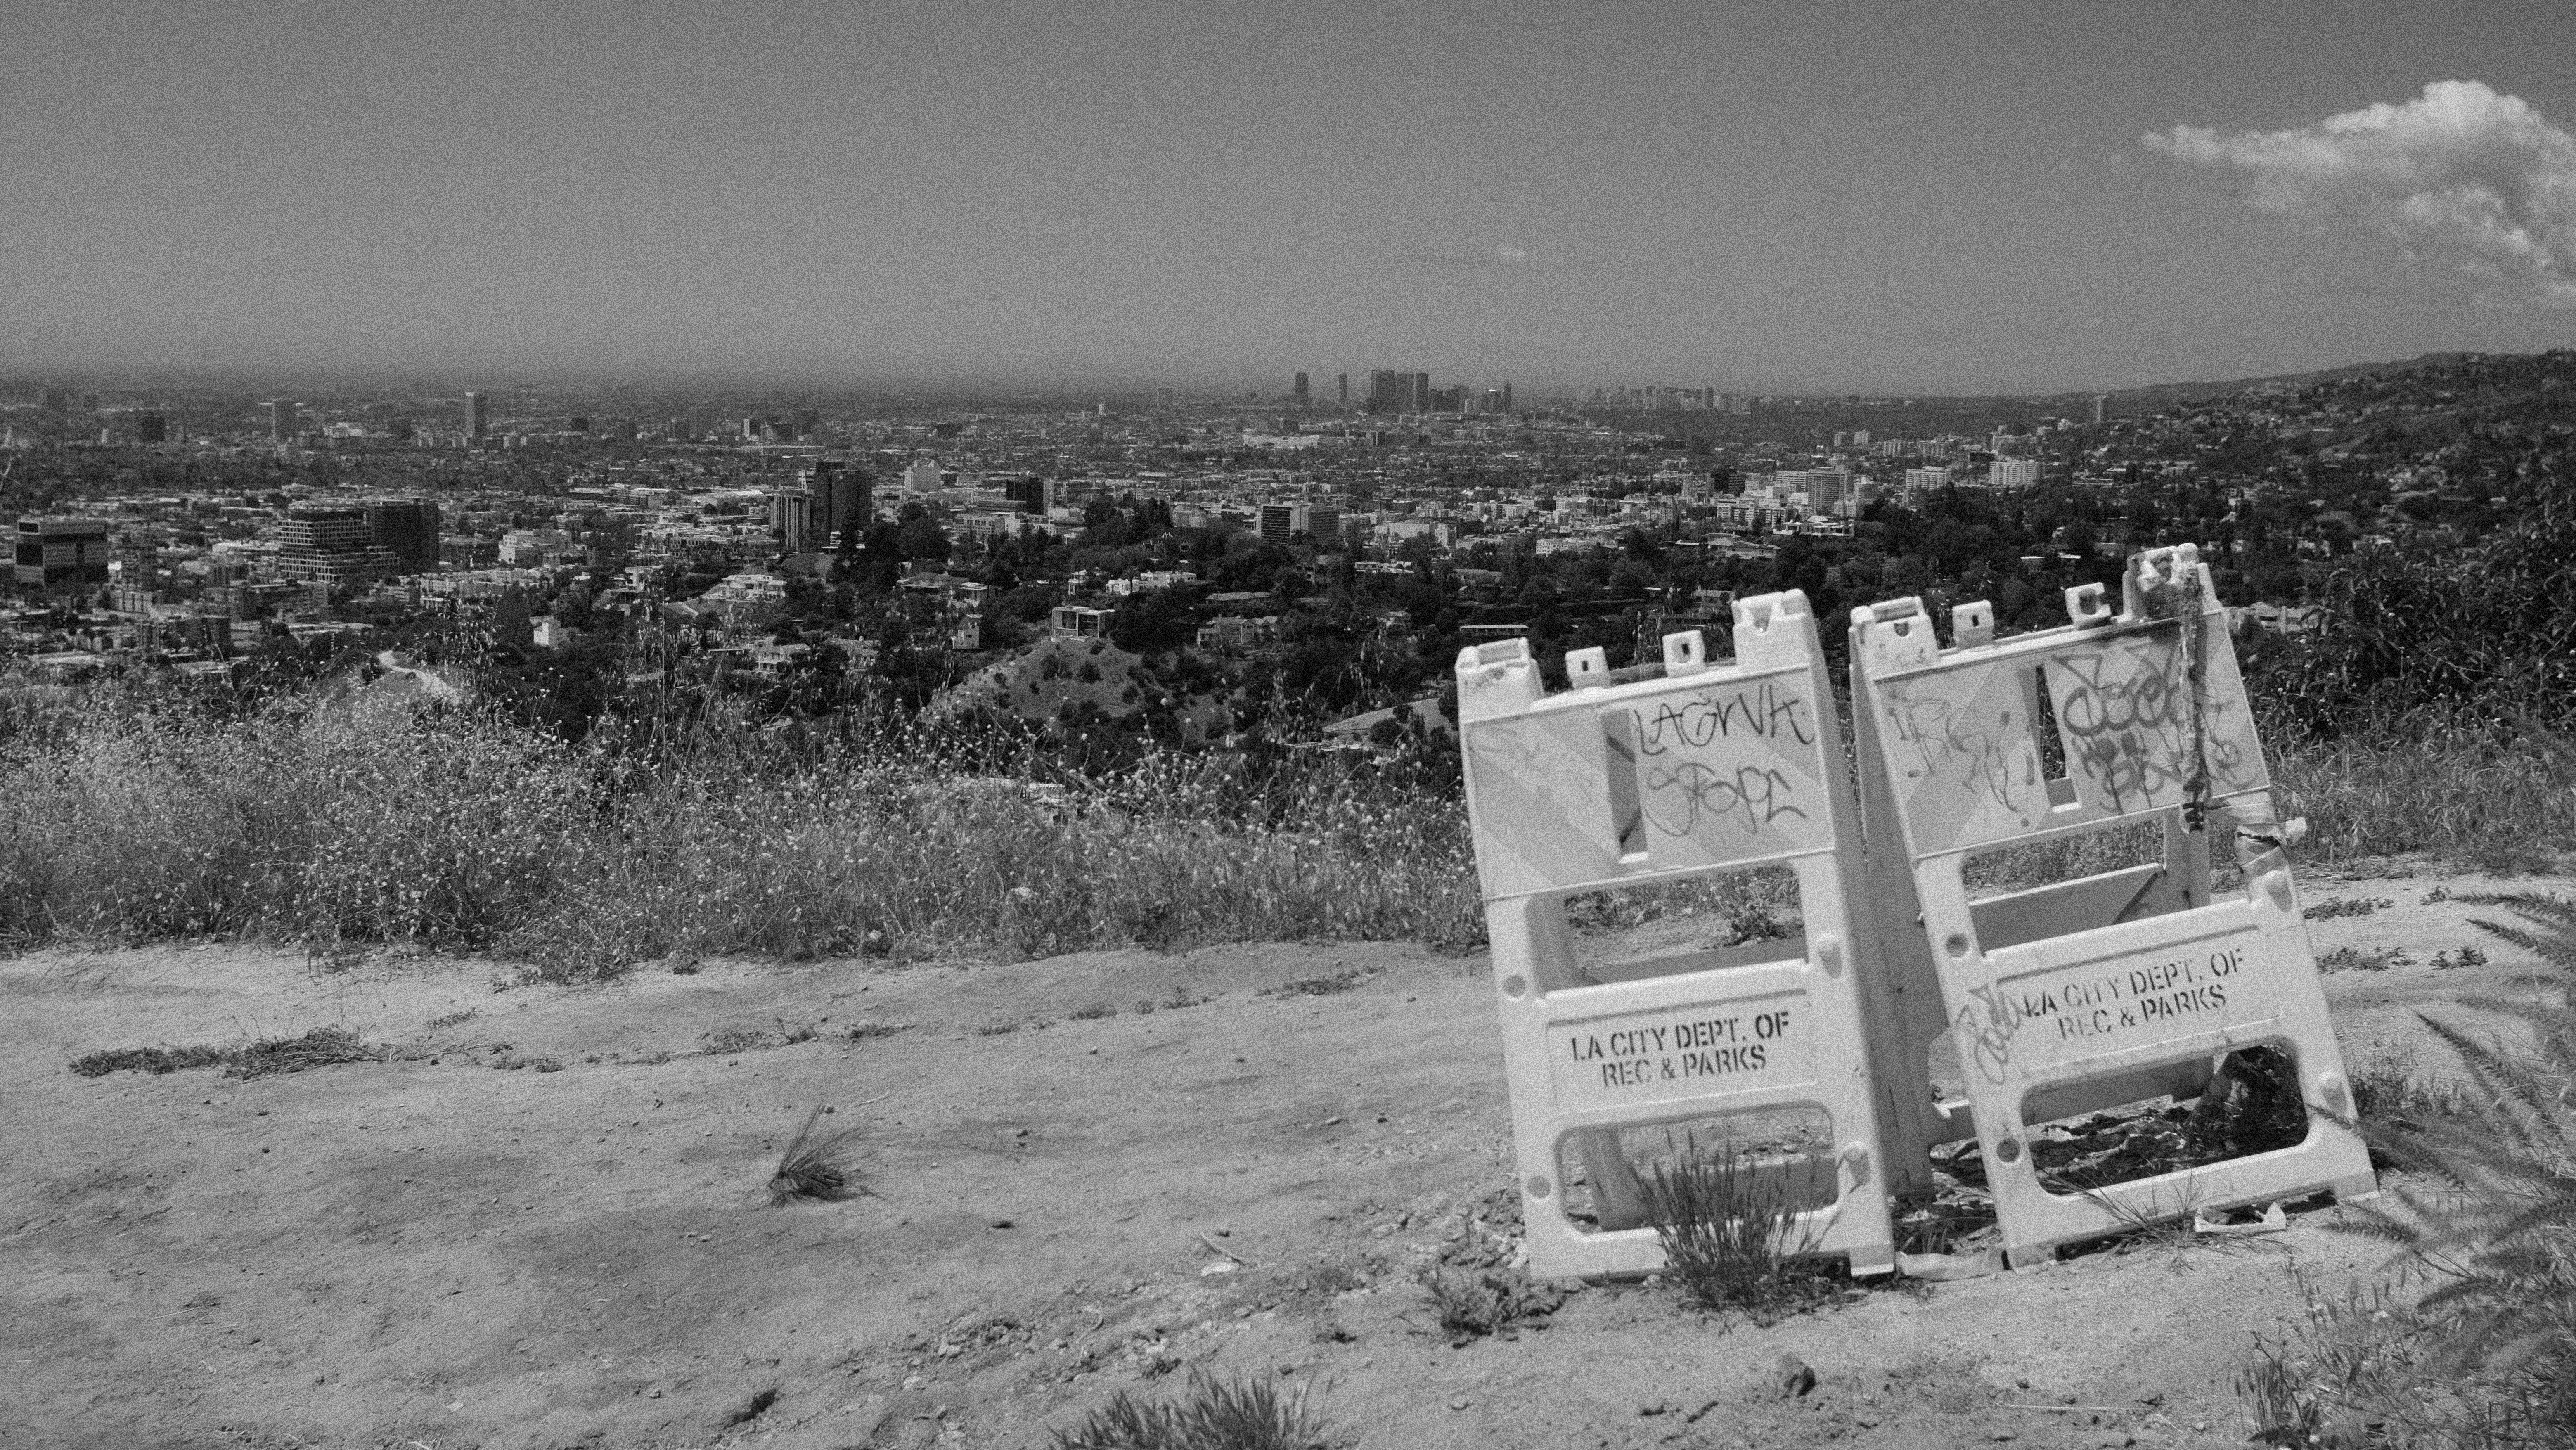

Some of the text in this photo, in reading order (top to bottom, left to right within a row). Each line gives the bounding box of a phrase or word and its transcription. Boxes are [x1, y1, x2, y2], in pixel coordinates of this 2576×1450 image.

[2023, 948, 2242, 1017] LA CITY DEPT. OF
[1572, 1011, 1788, 1061] LA CITY DEPT. OF
[2059, 984, 2226, 1040] REC & PARKS
[1602, 1045, 1766, 1087] REC & PARKS
